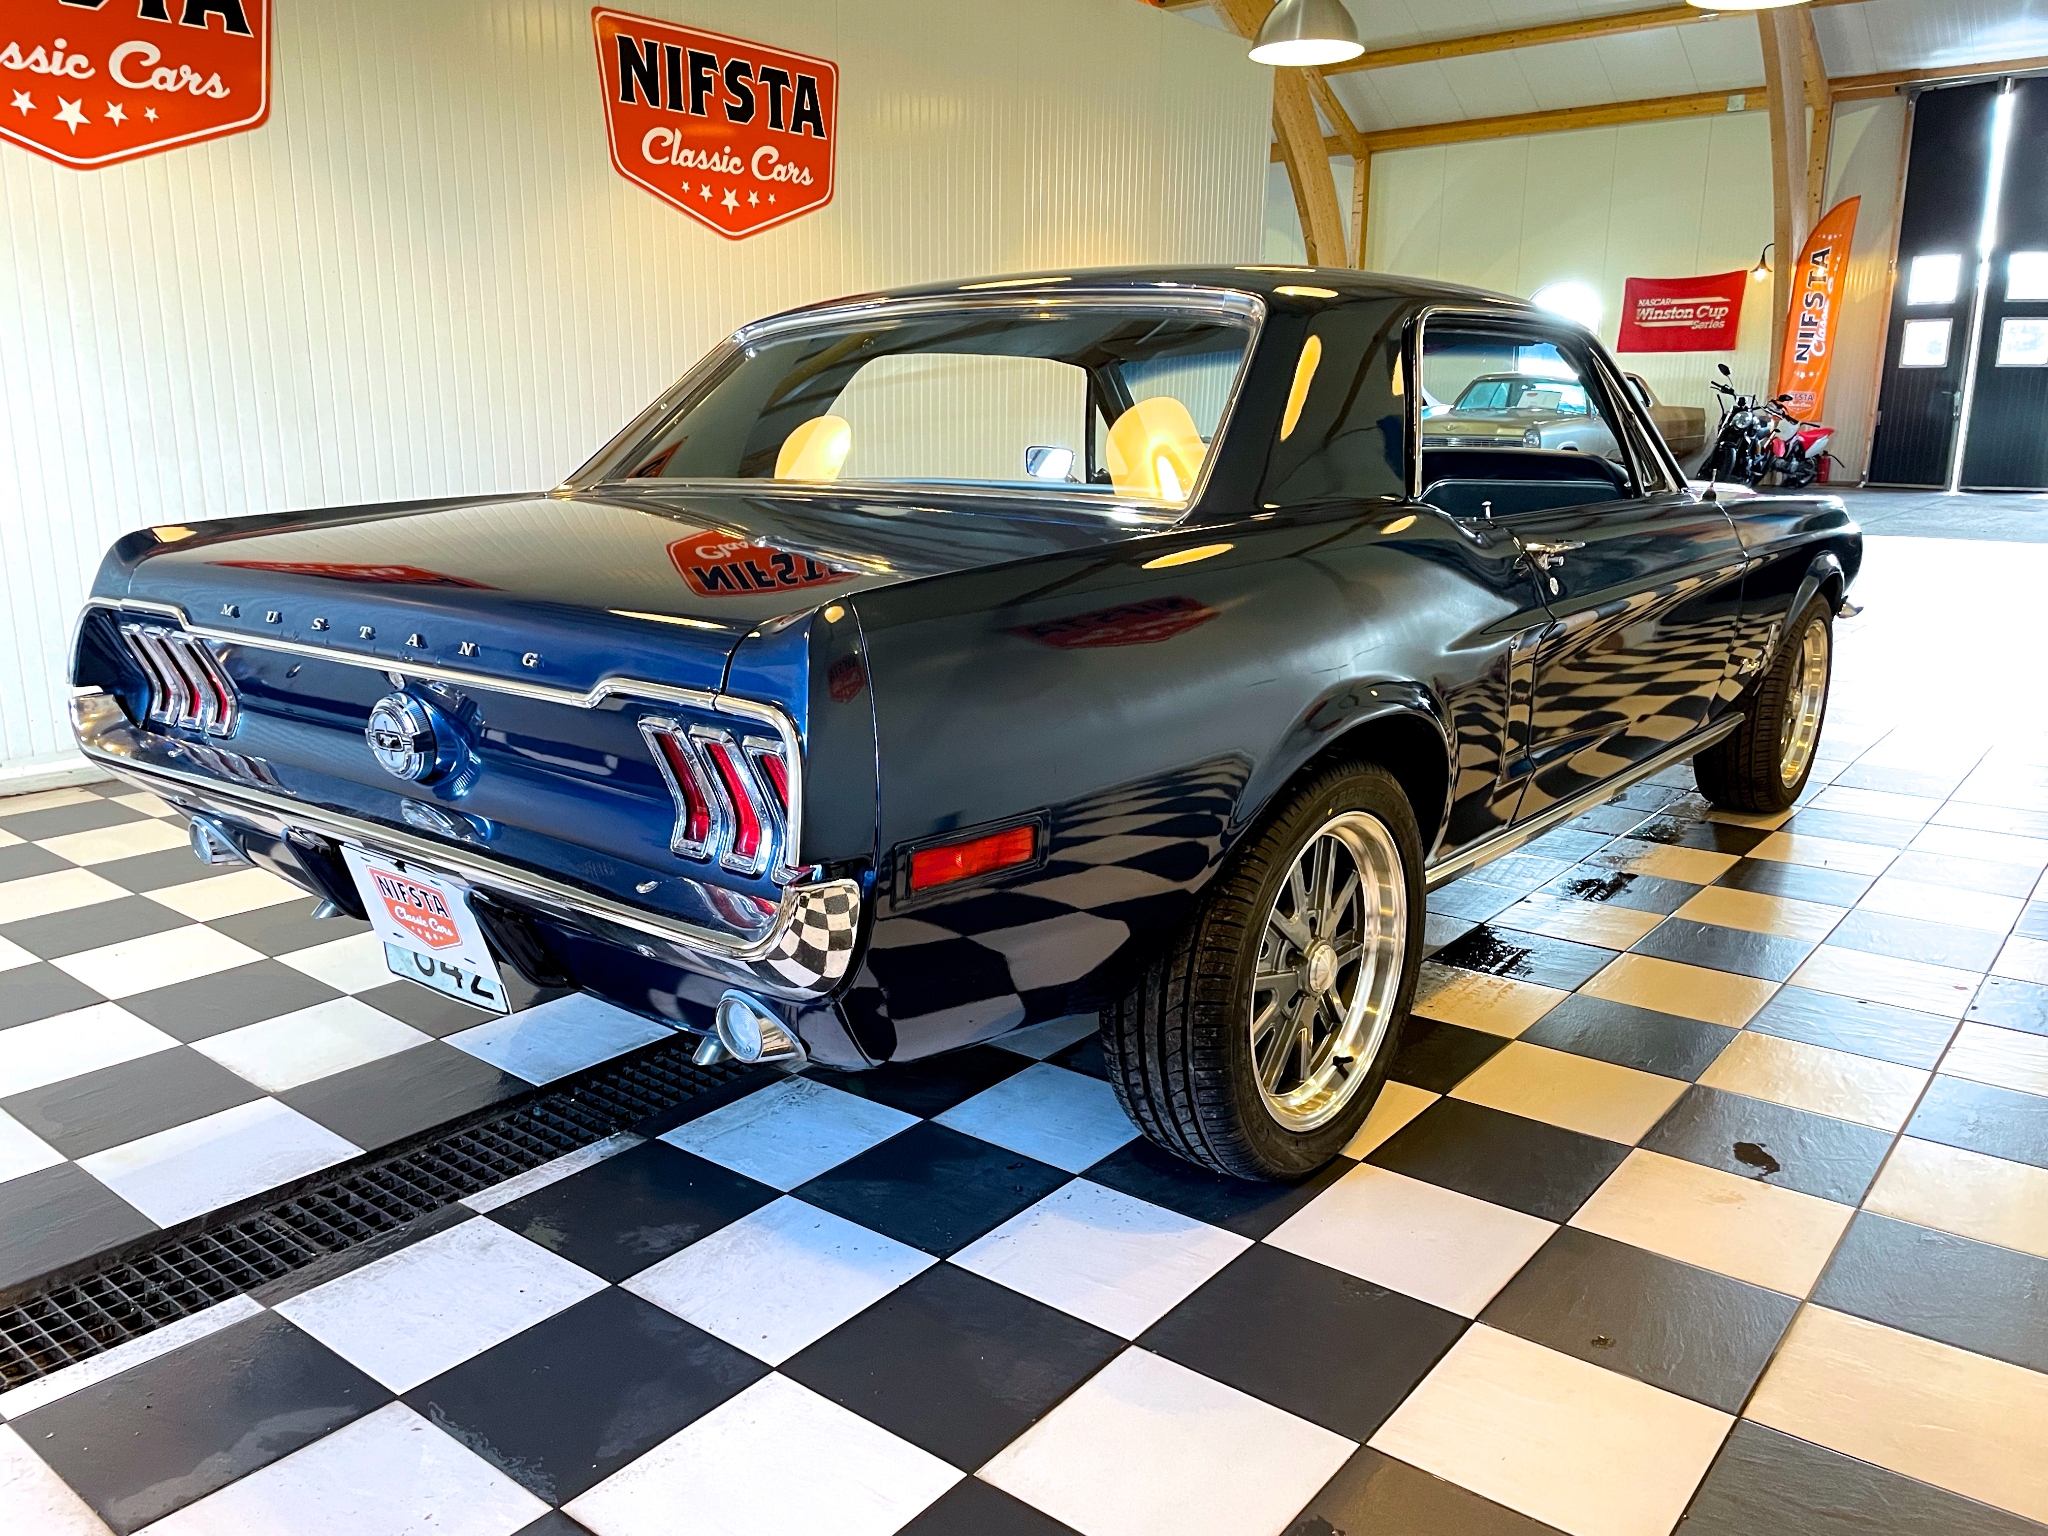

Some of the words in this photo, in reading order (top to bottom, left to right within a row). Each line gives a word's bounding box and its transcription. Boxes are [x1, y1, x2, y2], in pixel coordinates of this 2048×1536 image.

[108, 40, 231, 99] Cars
[614, 32, 828, 140] NIFSTA
[641, 126, 745, 175] Classic
[751, 145, 814, 186] Cars
[1636, 306, 1694, 321] Winston
[1696, 305, 1729, 319] Cup
[1637, 298, 1672, 307] NASCAR
[1691, 319, 1726, 330] Series
[1794, 246, 1832, 364] NIFSTA
[220, 603, 542, 669] MUSTANG
[374, 873, 453, 920] NIFSTA
[394, 905, 429, 928] Classic
[428, 917, 454, 937] Cars
